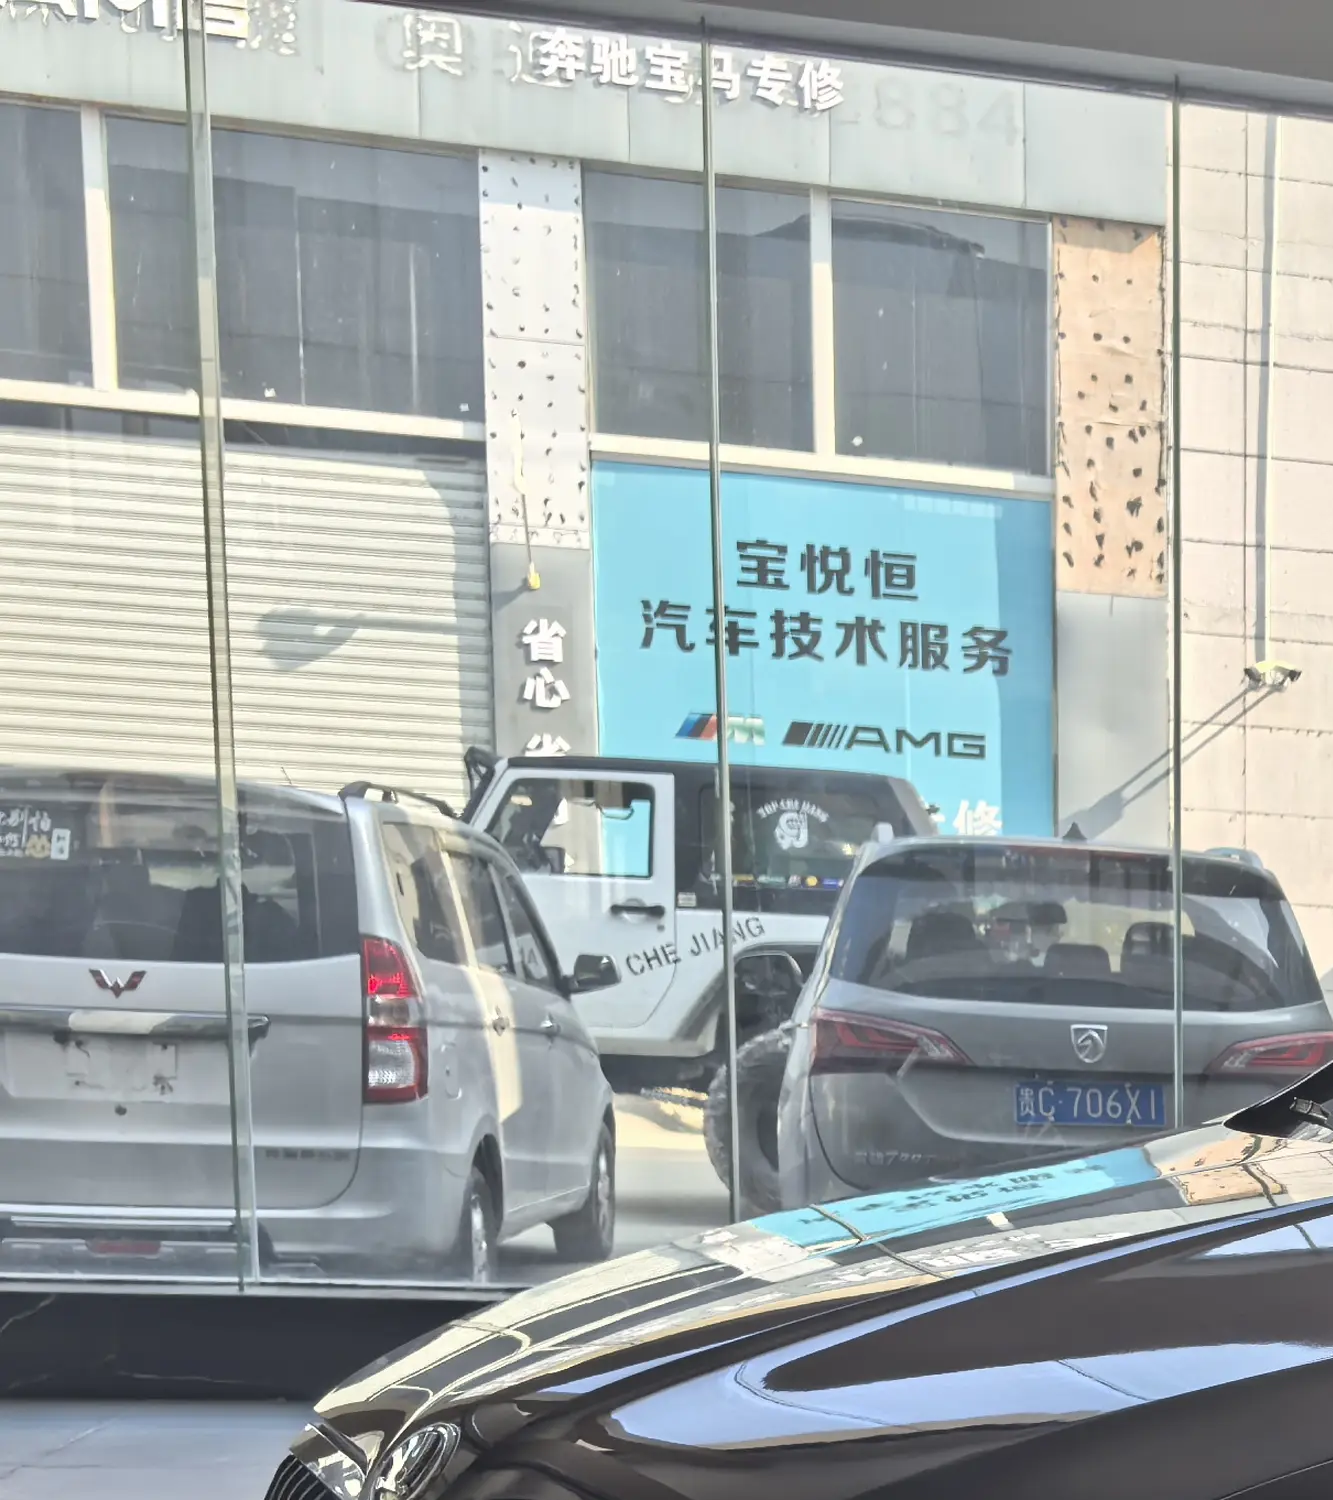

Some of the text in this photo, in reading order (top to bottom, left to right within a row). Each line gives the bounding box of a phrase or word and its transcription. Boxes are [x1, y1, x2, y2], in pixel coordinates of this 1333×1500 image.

[539, 27, 844, 113] 奔驰宝马专修
[736, 539, 918, 601] 宝悦恒
[640, 599, 1013, 676] 汽车技术服务
[844, 725, 986, 760] AMG
[626, 942, 682, 976] CHE
